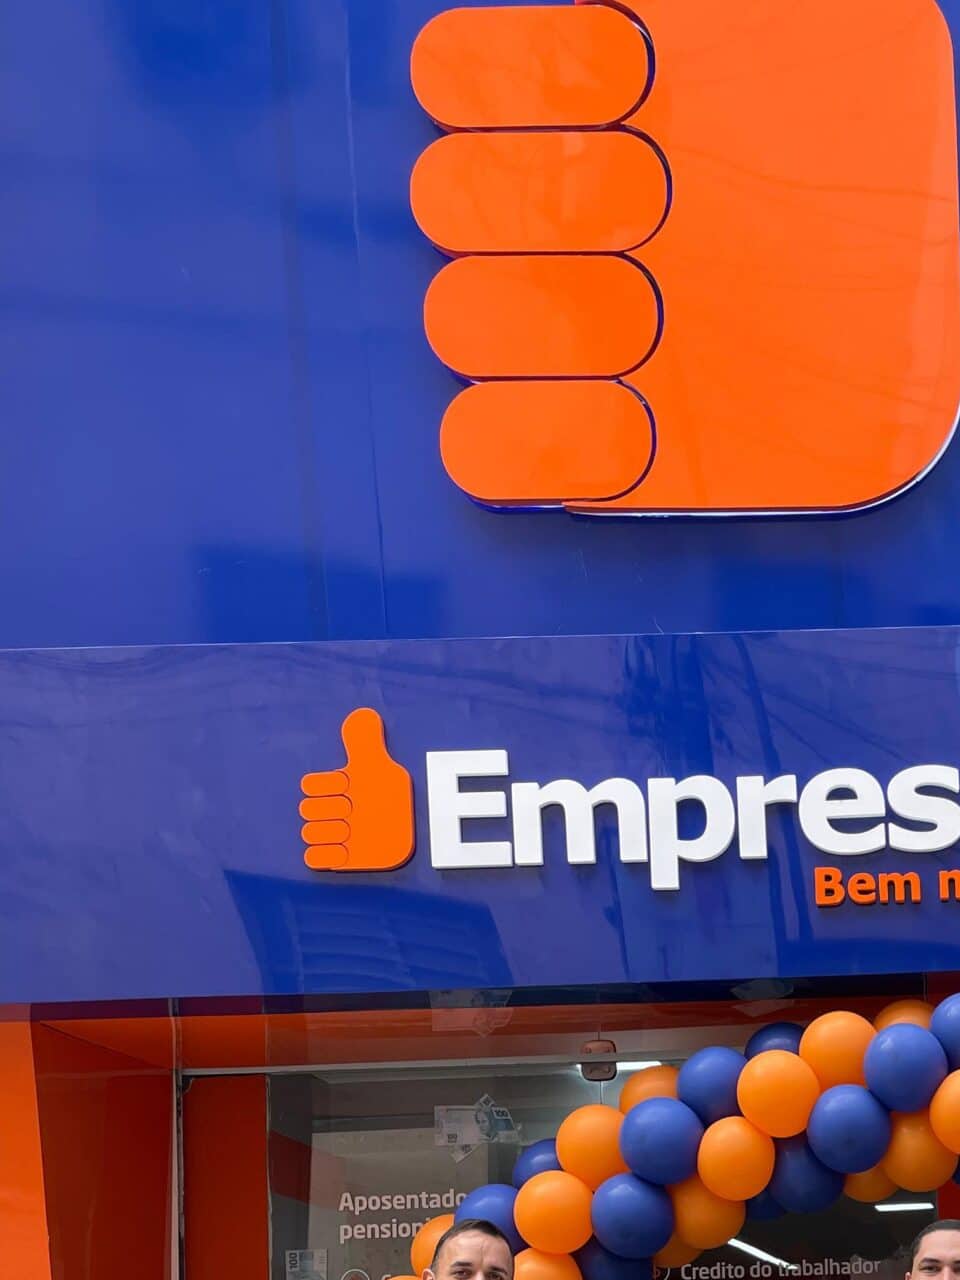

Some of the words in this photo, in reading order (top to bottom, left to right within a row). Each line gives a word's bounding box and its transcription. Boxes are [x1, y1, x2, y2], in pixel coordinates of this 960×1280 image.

[814, 866, 922, 906] Bem
[339, 1218, 432, 1244] pension
[680, 1262, 745, 1280] Credito
[750, 1261, 772, 1278] do
[778, 1257, 881, 1277] trabalhador
